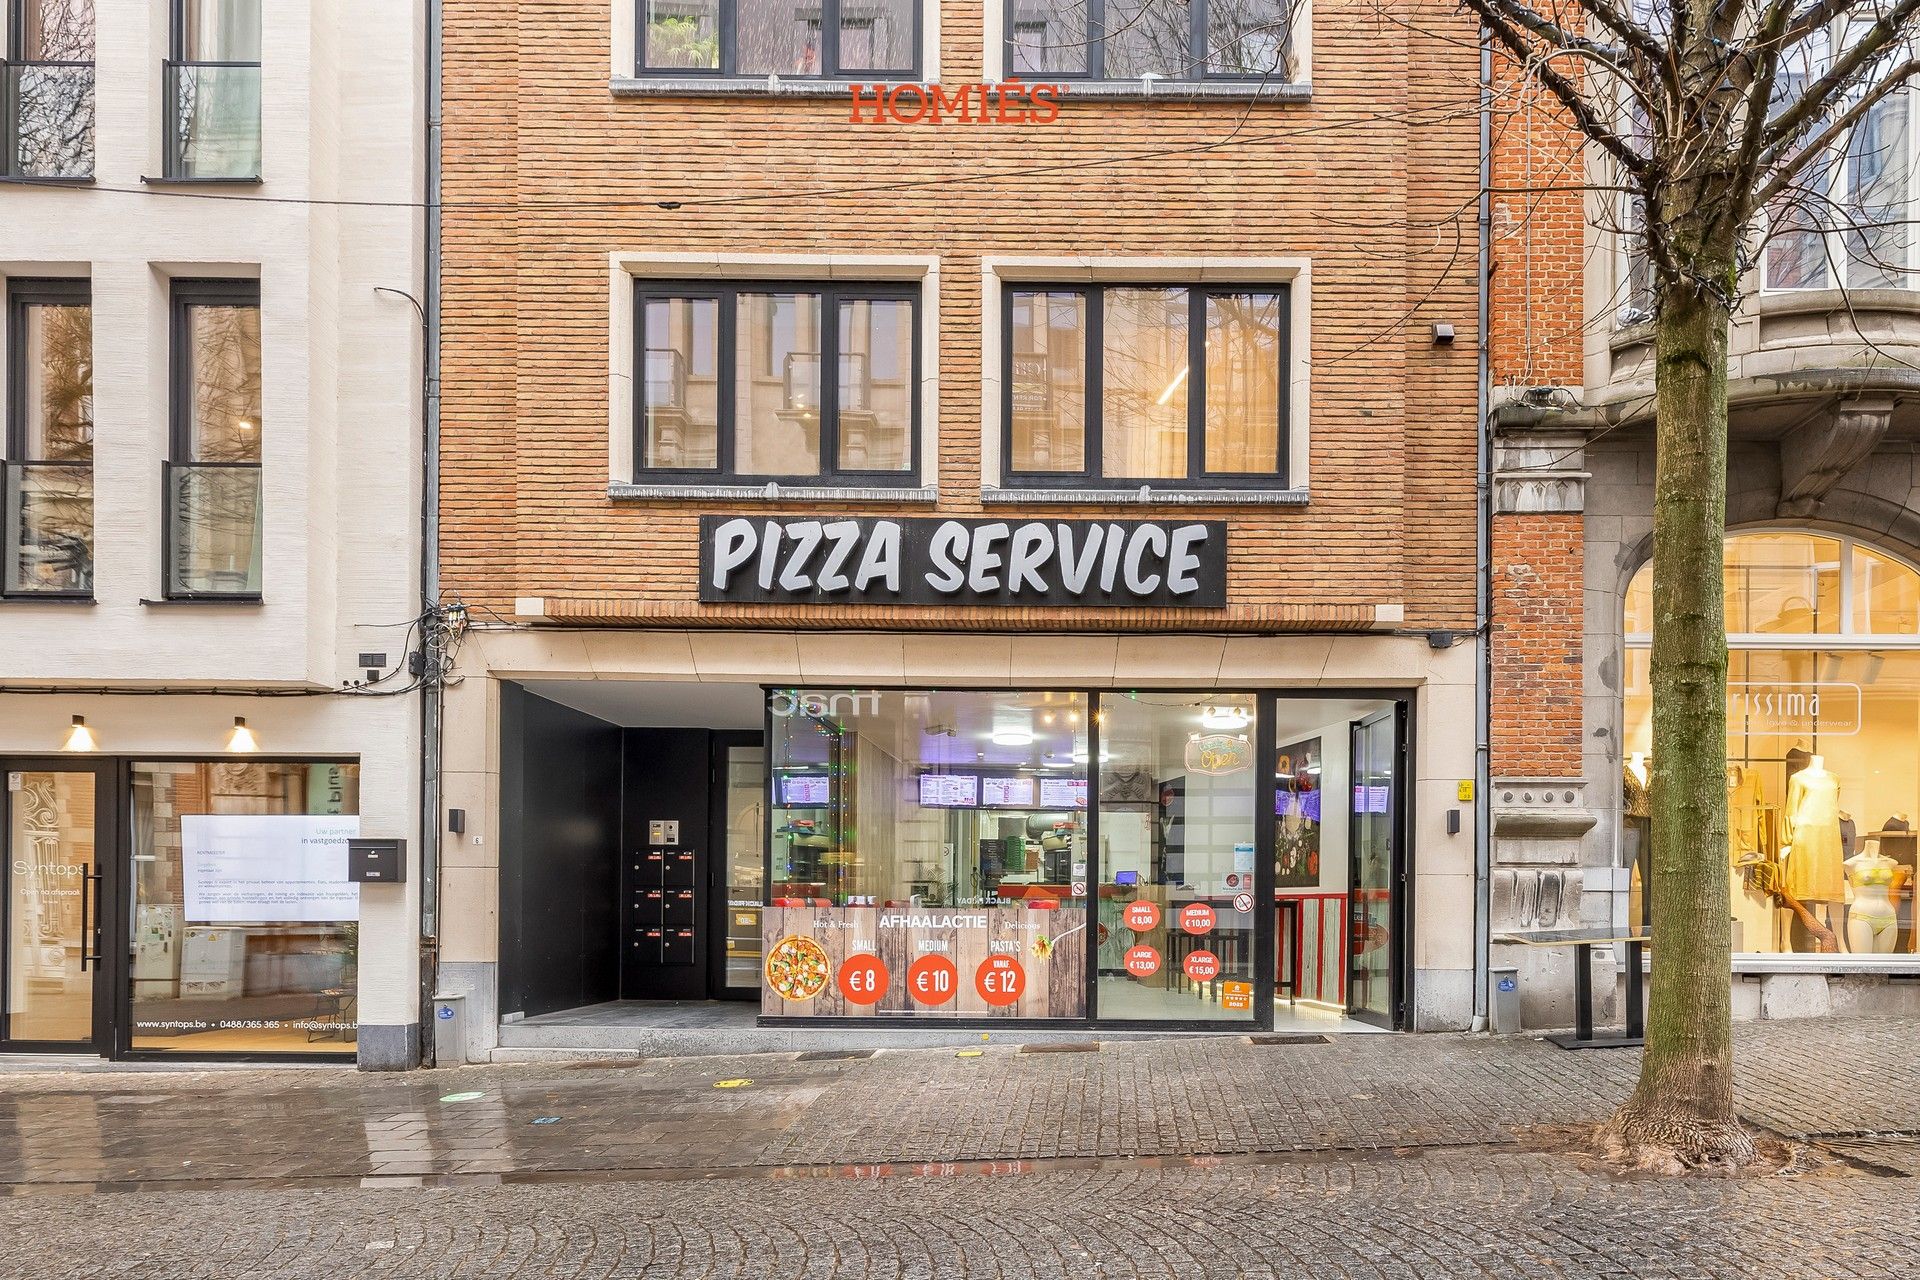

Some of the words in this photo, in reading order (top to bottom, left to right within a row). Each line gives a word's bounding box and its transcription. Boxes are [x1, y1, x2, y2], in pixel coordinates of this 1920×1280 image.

[711, 518, 901, 593] PIZZA
[924, 520, 1208, 596] SERVICE
[813, 920, 827, 929] Hot
[838, 920, 859, 929] Fresh
[879, 914, 987, 929] AFHAALACTIE
[1004, 920, 1041, 930] Delicious
[1191, 919, 1211, 928] 10,00
[852, 940, 876, 951] SMALL
[918, 940, 948, 951] MEDIUM
[990, 940, 1021, 952] PASTA'S
[849, 970, 862, 992] €
[865, 969, 876, 992] 8
[916, 971, 929, 992] €
[932, 969, 949, 992] 10
[983, 971, 996, 993] €
[1000, 970, 1016, 993] 12
[136, 1020, 207, 1029] www.syntops.be
[219, 1020, 262, 1029] 0488/365
[263, 1020, 280, 1028] 365
